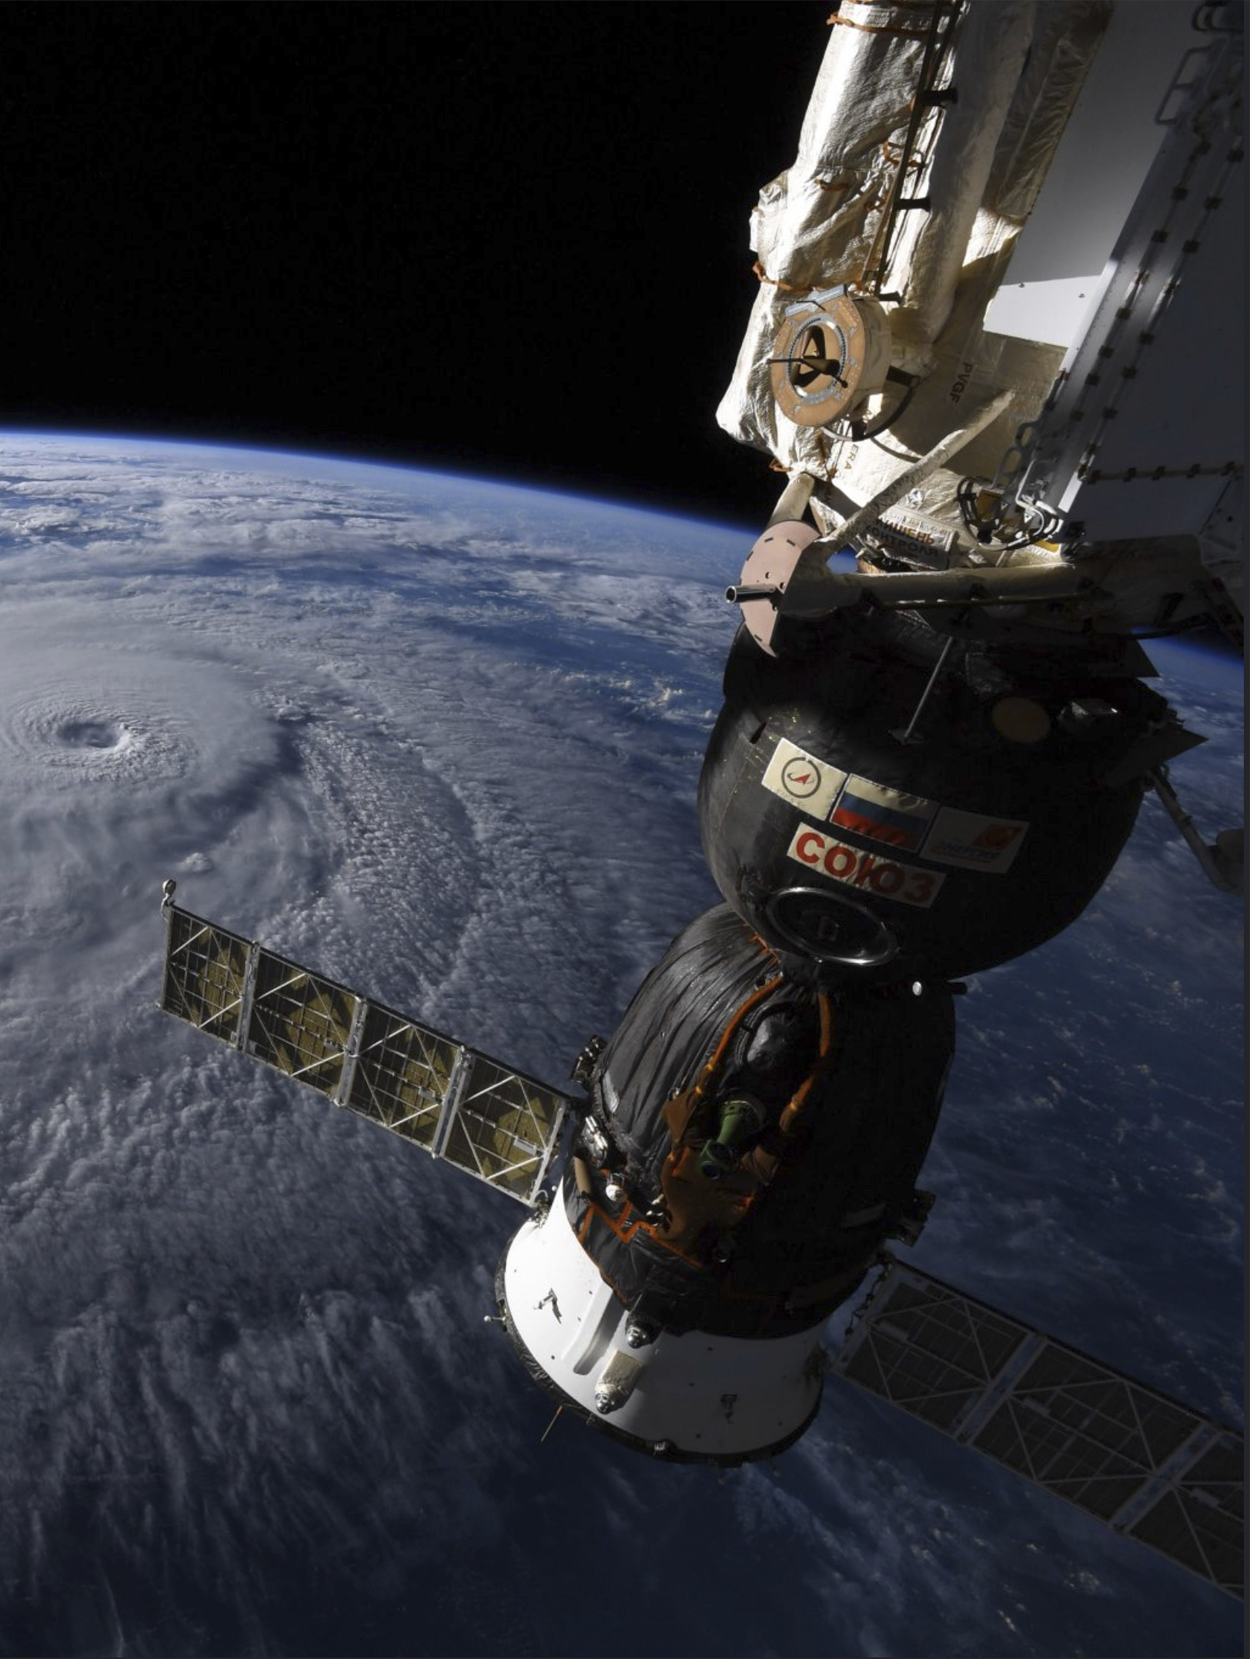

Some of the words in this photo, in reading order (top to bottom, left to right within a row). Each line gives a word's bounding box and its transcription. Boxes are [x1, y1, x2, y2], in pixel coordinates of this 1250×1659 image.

[948, 362, 974, 403] PVGF
[844, 444, 859, 470] ERA
[796, 832, 935, 902] СОЮЗ
